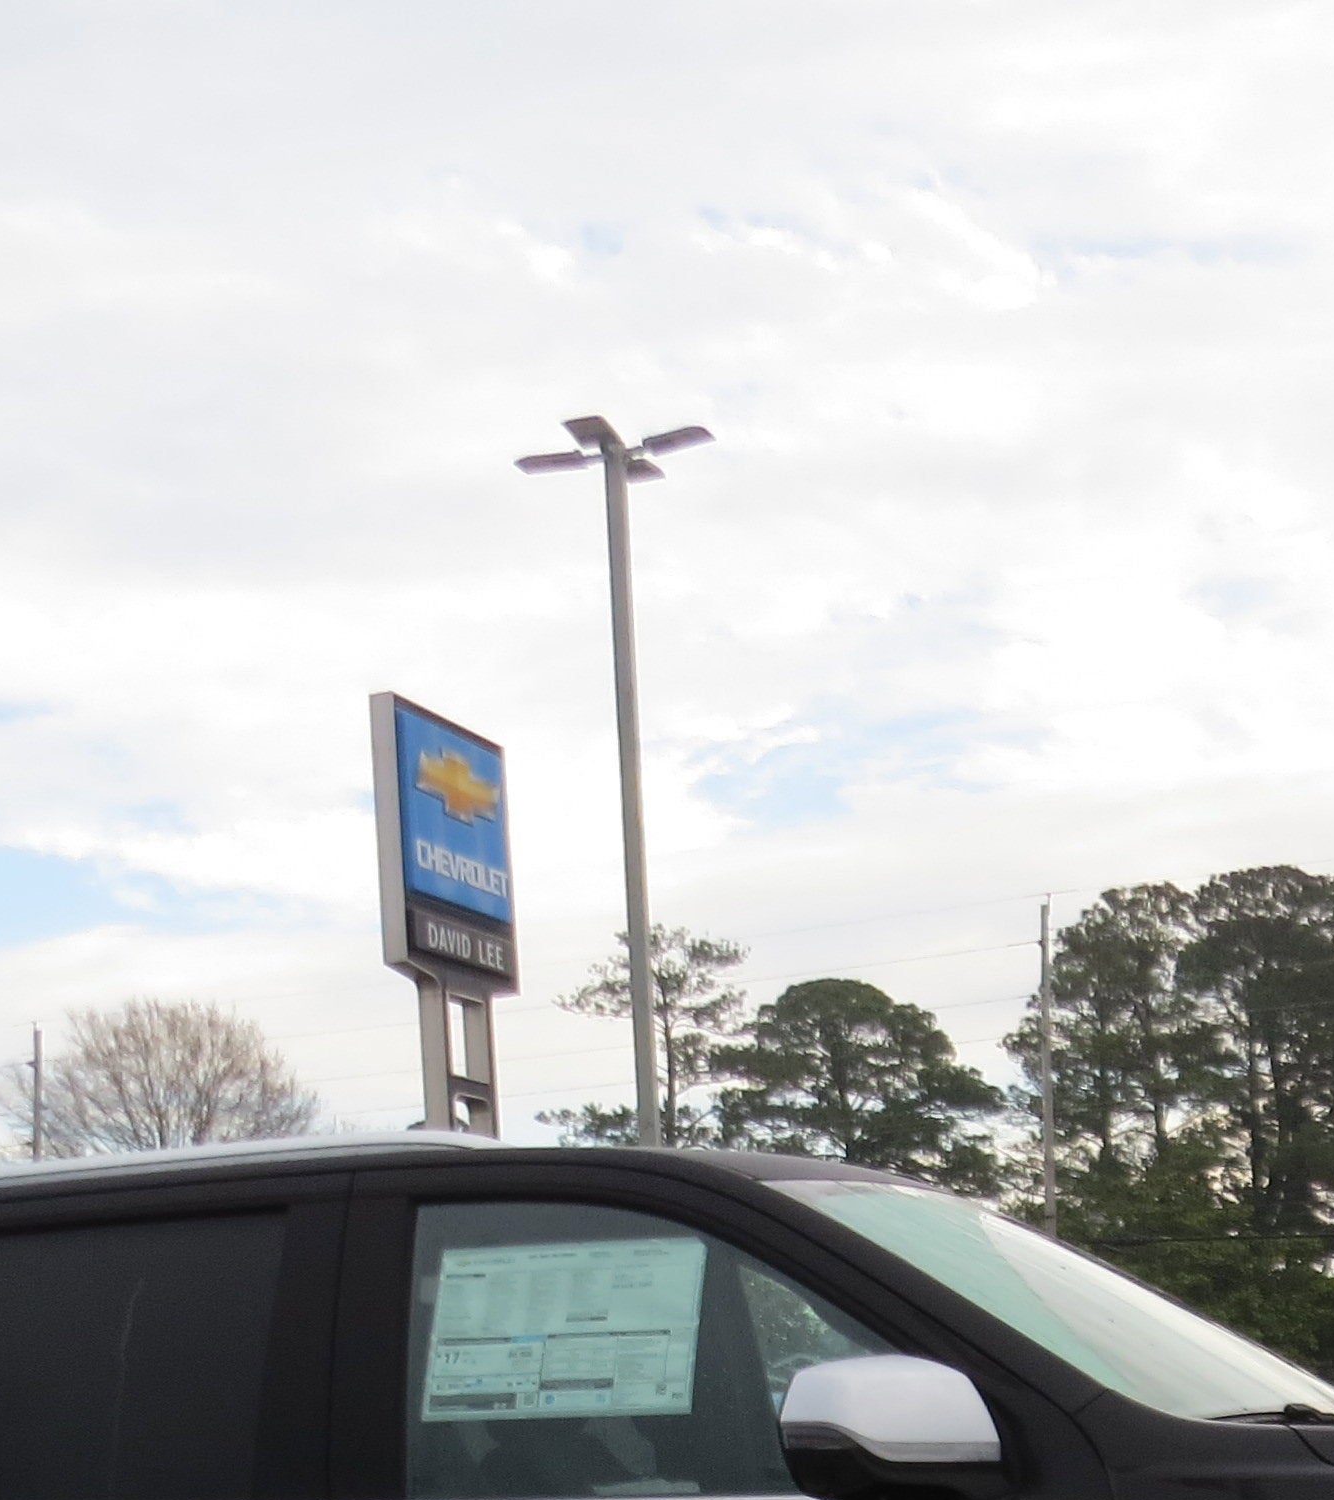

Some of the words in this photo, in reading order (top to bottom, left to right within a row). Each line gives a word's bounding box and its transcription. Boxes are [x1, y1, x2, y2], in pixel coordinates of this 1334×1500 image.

[416, 839, 508, 898] CHEVROLET
[427, 922, 471, 959] DAVID
[478, 940, 505, 971] LEE
